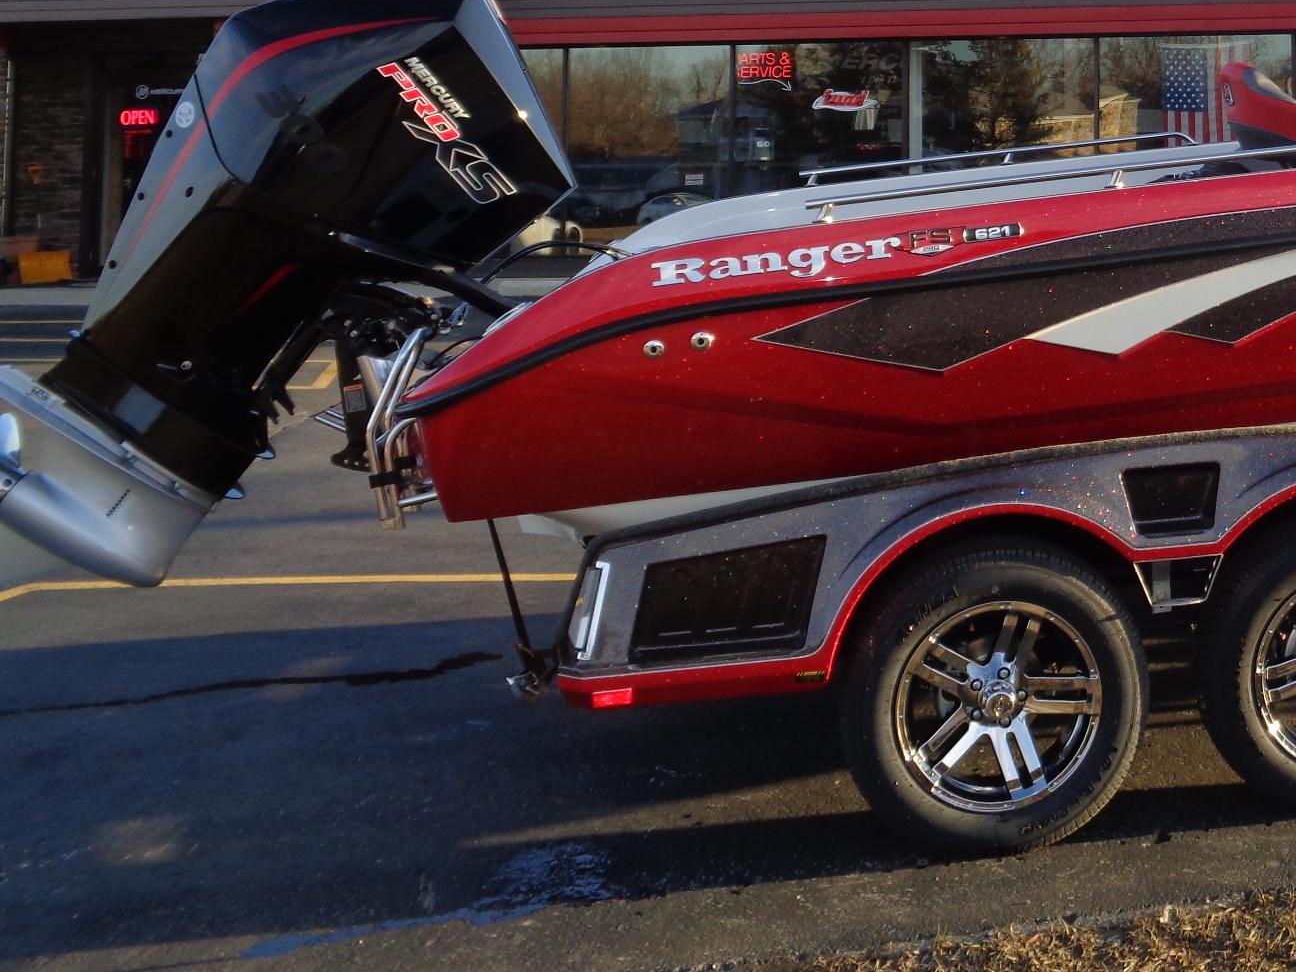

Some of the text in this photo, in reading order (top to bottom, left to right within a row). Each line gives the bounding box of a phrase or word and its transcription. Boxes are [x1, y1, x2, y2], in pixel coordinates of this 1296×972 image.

[403, 56, 470, 118] MERCURY
[737, 51, 790, 65] ARTS &
[737, 65, 792, 78] ERVICE
[120, 110, 156, 125] OPEN
[376, 62, 460, 142] PRO
[401, 111, 517, 204] XS
[651, 225, 1011, 288] Ranger FS 621
